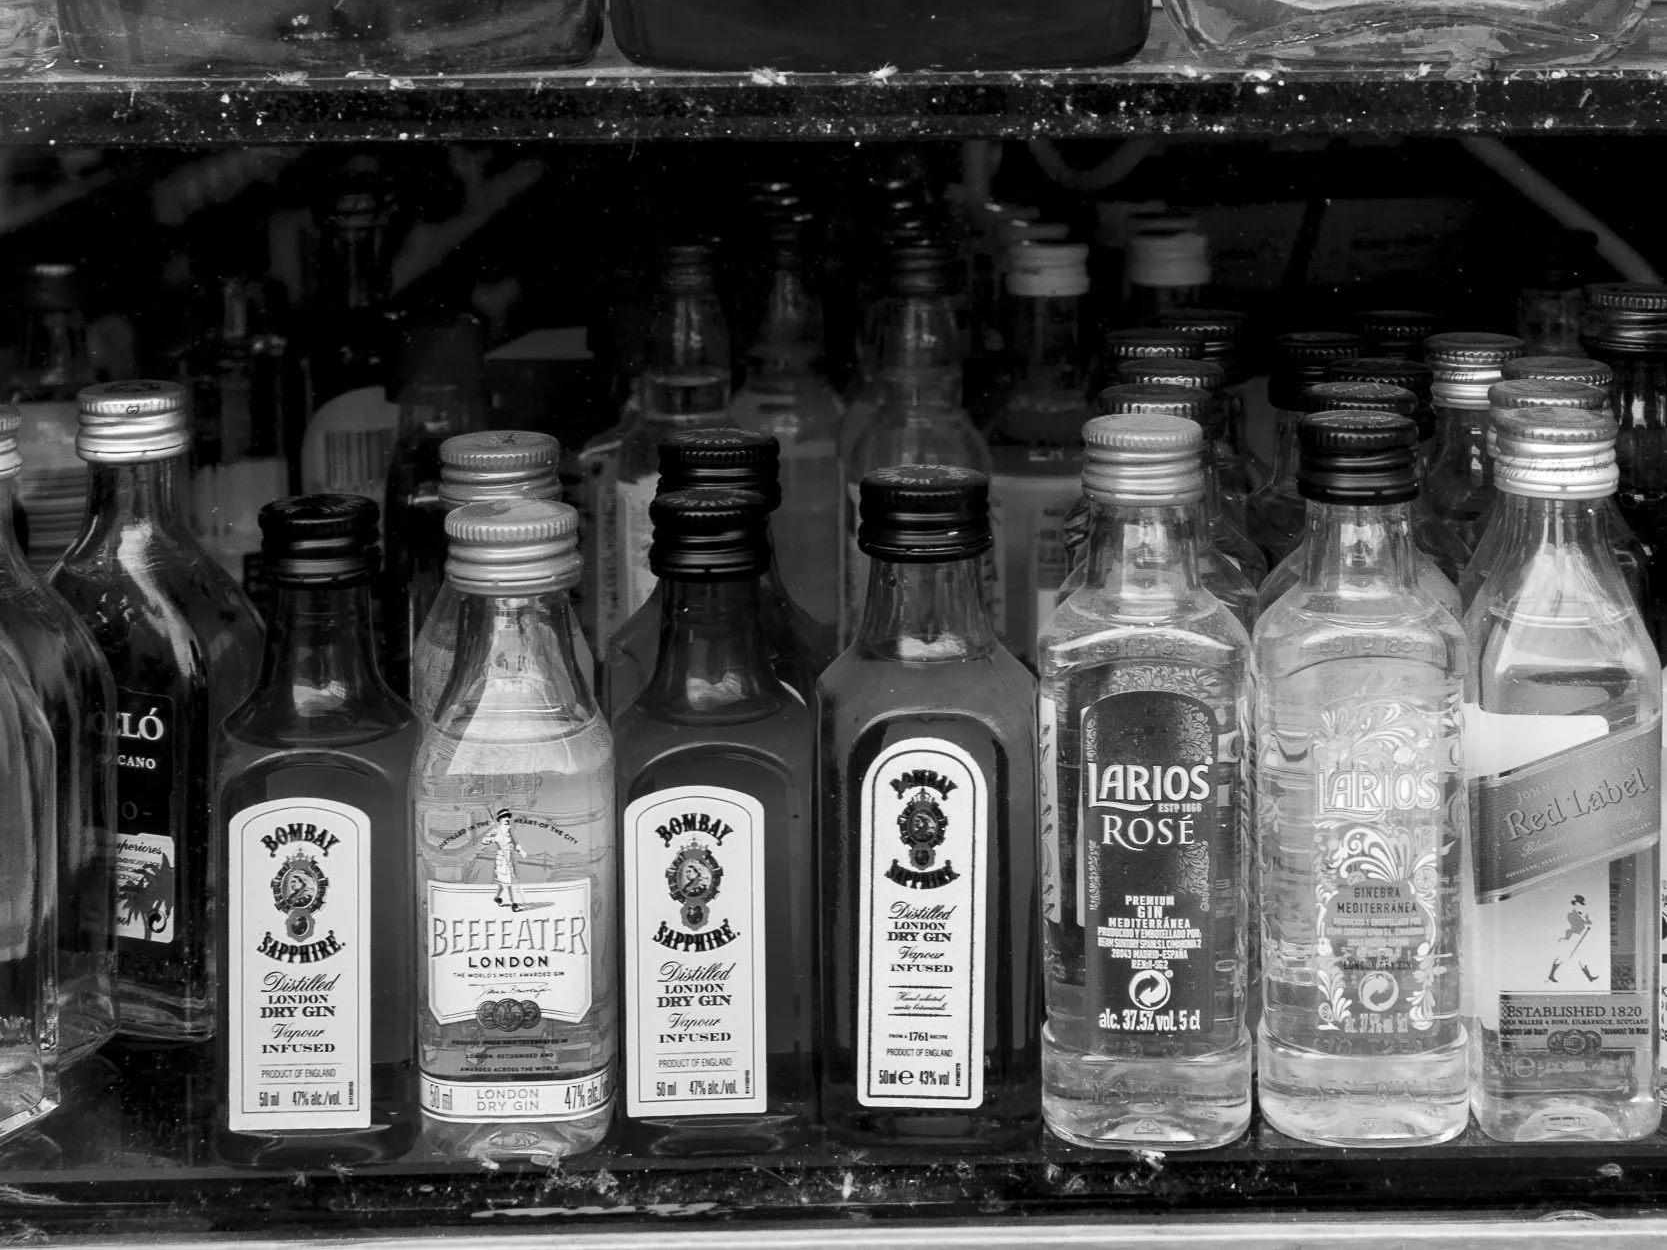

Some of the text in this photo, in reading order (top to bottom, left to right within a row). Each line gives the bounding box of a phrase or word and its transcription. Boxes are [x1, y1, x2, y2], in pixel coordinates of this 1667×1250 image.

[1087, 762, 1211, 812] LARIOS
[1315, 768, 1441, 820] LARIOS
[1505, 797, 1567, 843] Red
[1572, 766, 1650, 820] Label
[654, 812, 734, 848] BOMBAY
[1100, 813, 1195, 851] ROSÉ
[260, 823, 341, 858] BOMBAY
[1353, 886, 1402, 899] GINEBRA
[1125, 894, 1175, 906] PREMIUM
[887, 900, 958, 921] Distilled
[1137, 905, 1163, 919] GIN
[1336, 901, 1418, 914] MEDITERRÁNEA
[894, 921, 946, 931] LONDON
[1107, 916, 1192, 930] MEDITERRÁNEA
[430, 915, 590, 958] BEEFEATER
[887, 931, 953, 942] DRY GIN
[898, 945, 945, 963] Vapour
[468, 955, 550, 969] LONDON
[890, 963, 954, 973] INFUSED
[657, 960, 737, 983] Distilled
[260, 970, 342, 993] Distilled
[665, 983, 725, 994] LONDON
[267, 994, 330, 1005] LONDON
[657, 994, 733, 1008] DRY GIN
[260, 1005, 337, 1019] DRY GIN
[1505, 1006, 1643, 1018] ESTABLISHED 1820
[668, 1011, 722, 1032] Vapour
[1099, 1008, 1121, 1030] alc.
[1179, 1009, 1188, 1031] 5
[271, 1022, 326, 1043] Vapour
[659, 1032, 732, 1044] INFUSED
[909, 1031, 929, 1042] 1761
[262, 1043, 336, 1054] INFUSED
[886, 1047, 953, 1058] PRODUCT OF ENGLAND
[658, 1058, 690, 1069] PRODUCT
[691, 1058, 701, 1068] OF
[261, 1068, 293, 1079] PRODUCT
[294, 1069, 304, 1078] OF
[476, 1088, 540, 1101] LONDON
[476, 1100, 540, 1112] DRY GIN
